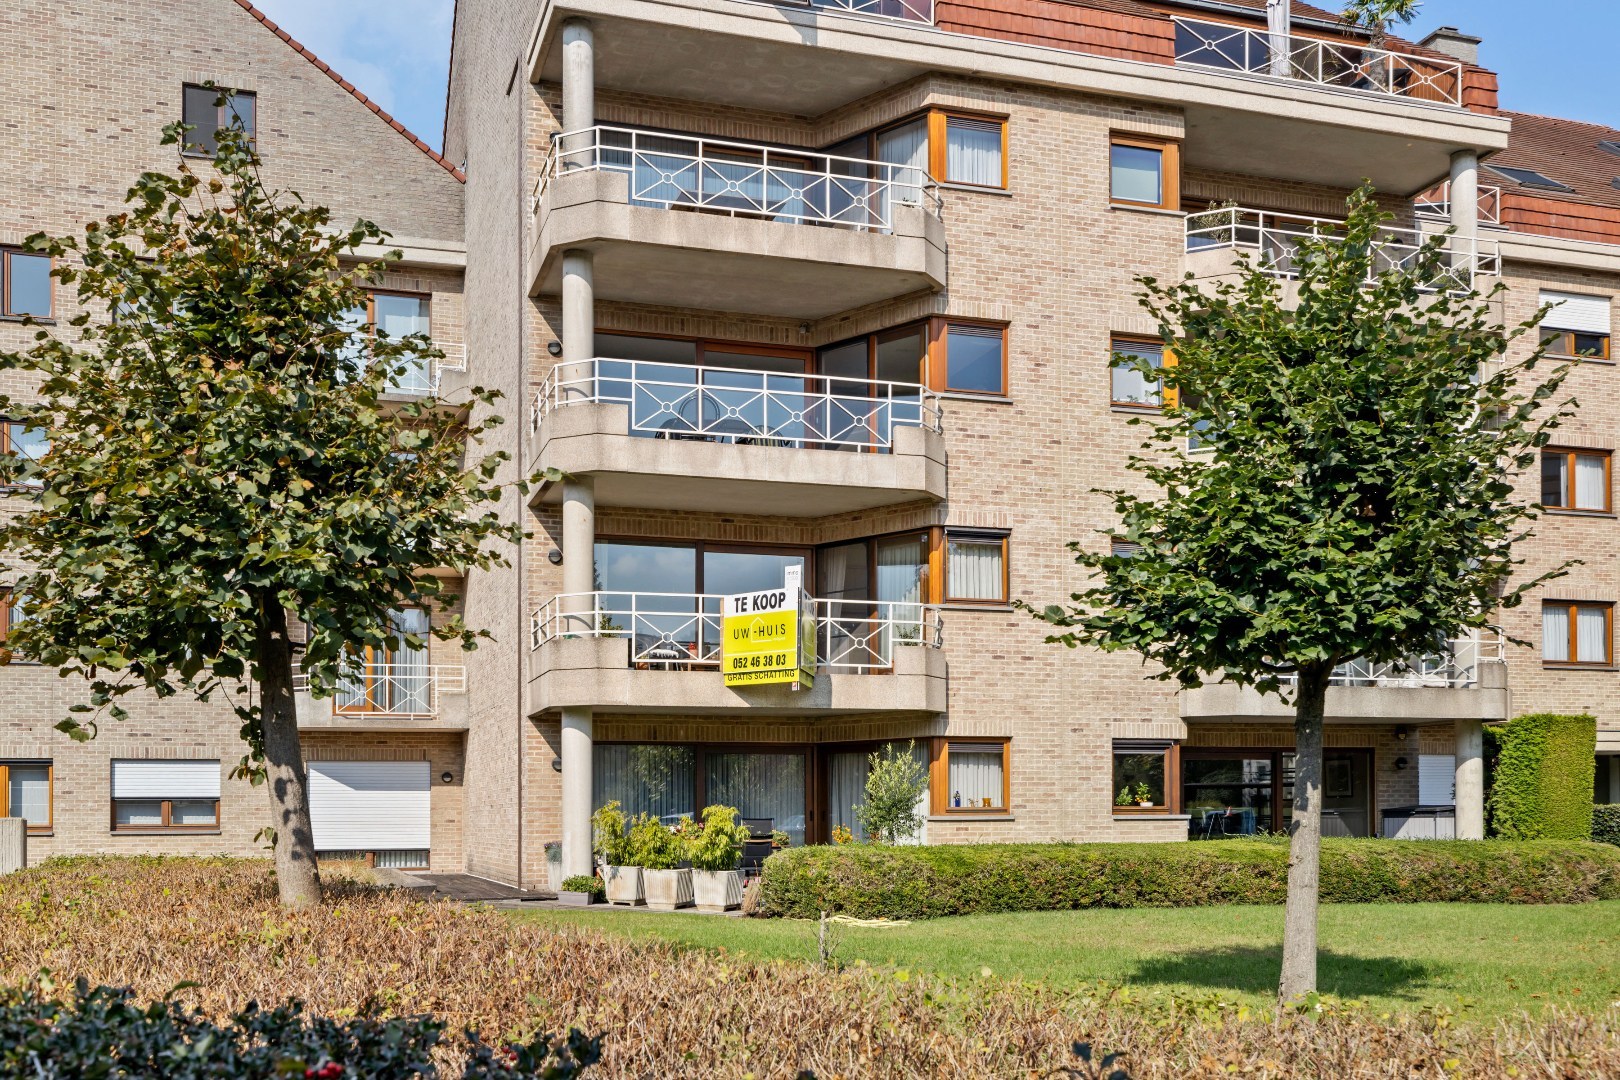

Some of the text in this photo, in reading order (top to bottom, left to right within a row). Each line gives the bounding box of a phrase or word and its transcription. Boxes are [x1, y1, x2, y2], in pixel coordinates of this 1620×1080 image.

[735, 597, 748, 613] TE
[753, 592, 786, 611] KOOP
[733, 653, 786, 669] 052 46 38 03
[727, 672, 753, 681] GRATIS
[754, 669, 795, 680] SCHATTING
